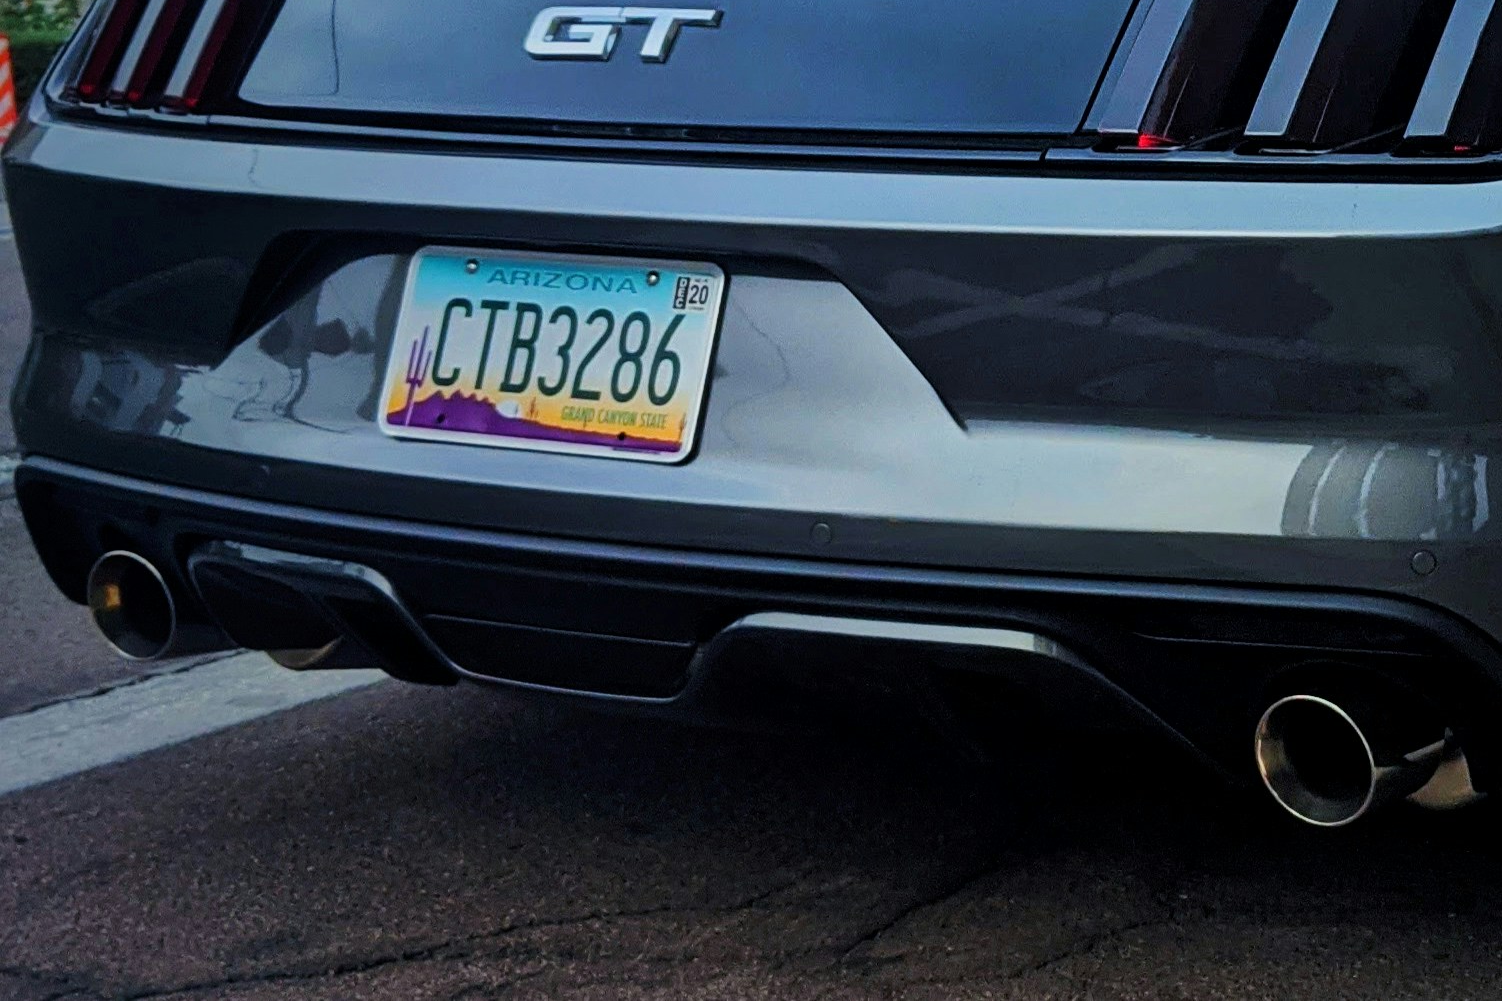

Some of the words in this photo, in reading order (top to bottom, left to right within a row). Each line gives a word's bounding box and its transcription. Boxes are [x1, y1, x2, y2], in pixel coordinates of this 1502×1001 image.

[524, 6, 725, 63] GT
[488, 269, 638, 294] ARIZONA
[689, 284, 709, 305] 20
[431, 297, 686, 406] CTB3286
[560, 405, 595, 423] GRAND
[598, 408, 637, 427] CANYON
[640, 412, 668, 429] STATE
